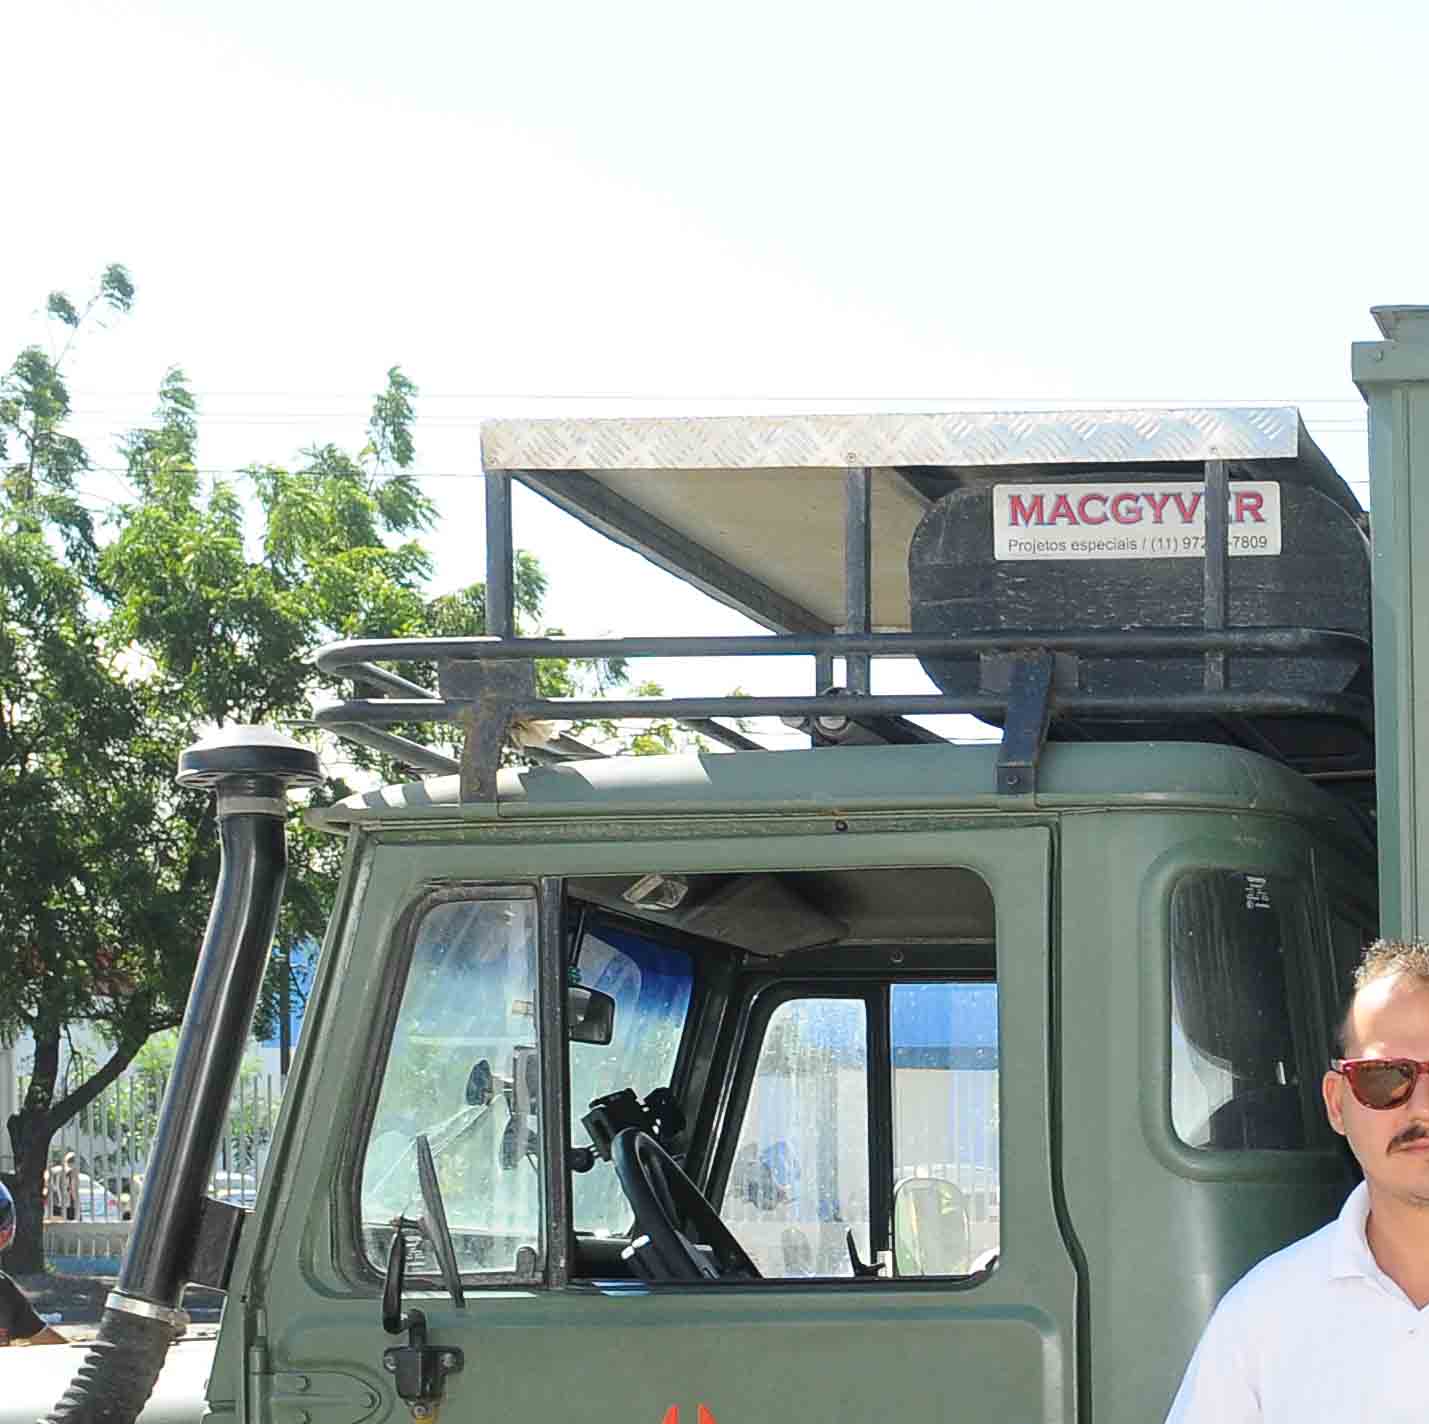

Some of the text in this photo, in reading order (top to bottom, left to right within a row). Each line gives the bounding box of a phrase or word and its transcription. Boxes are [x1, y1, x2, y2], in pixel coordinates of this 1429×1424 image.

[1008, 492, 1266, 526] MACGYVR
[1008, 539, 1066, 552] Projetos
[1071, 538, 1137, 552] especiais
[1151, 536, 1178, 552] (11)
